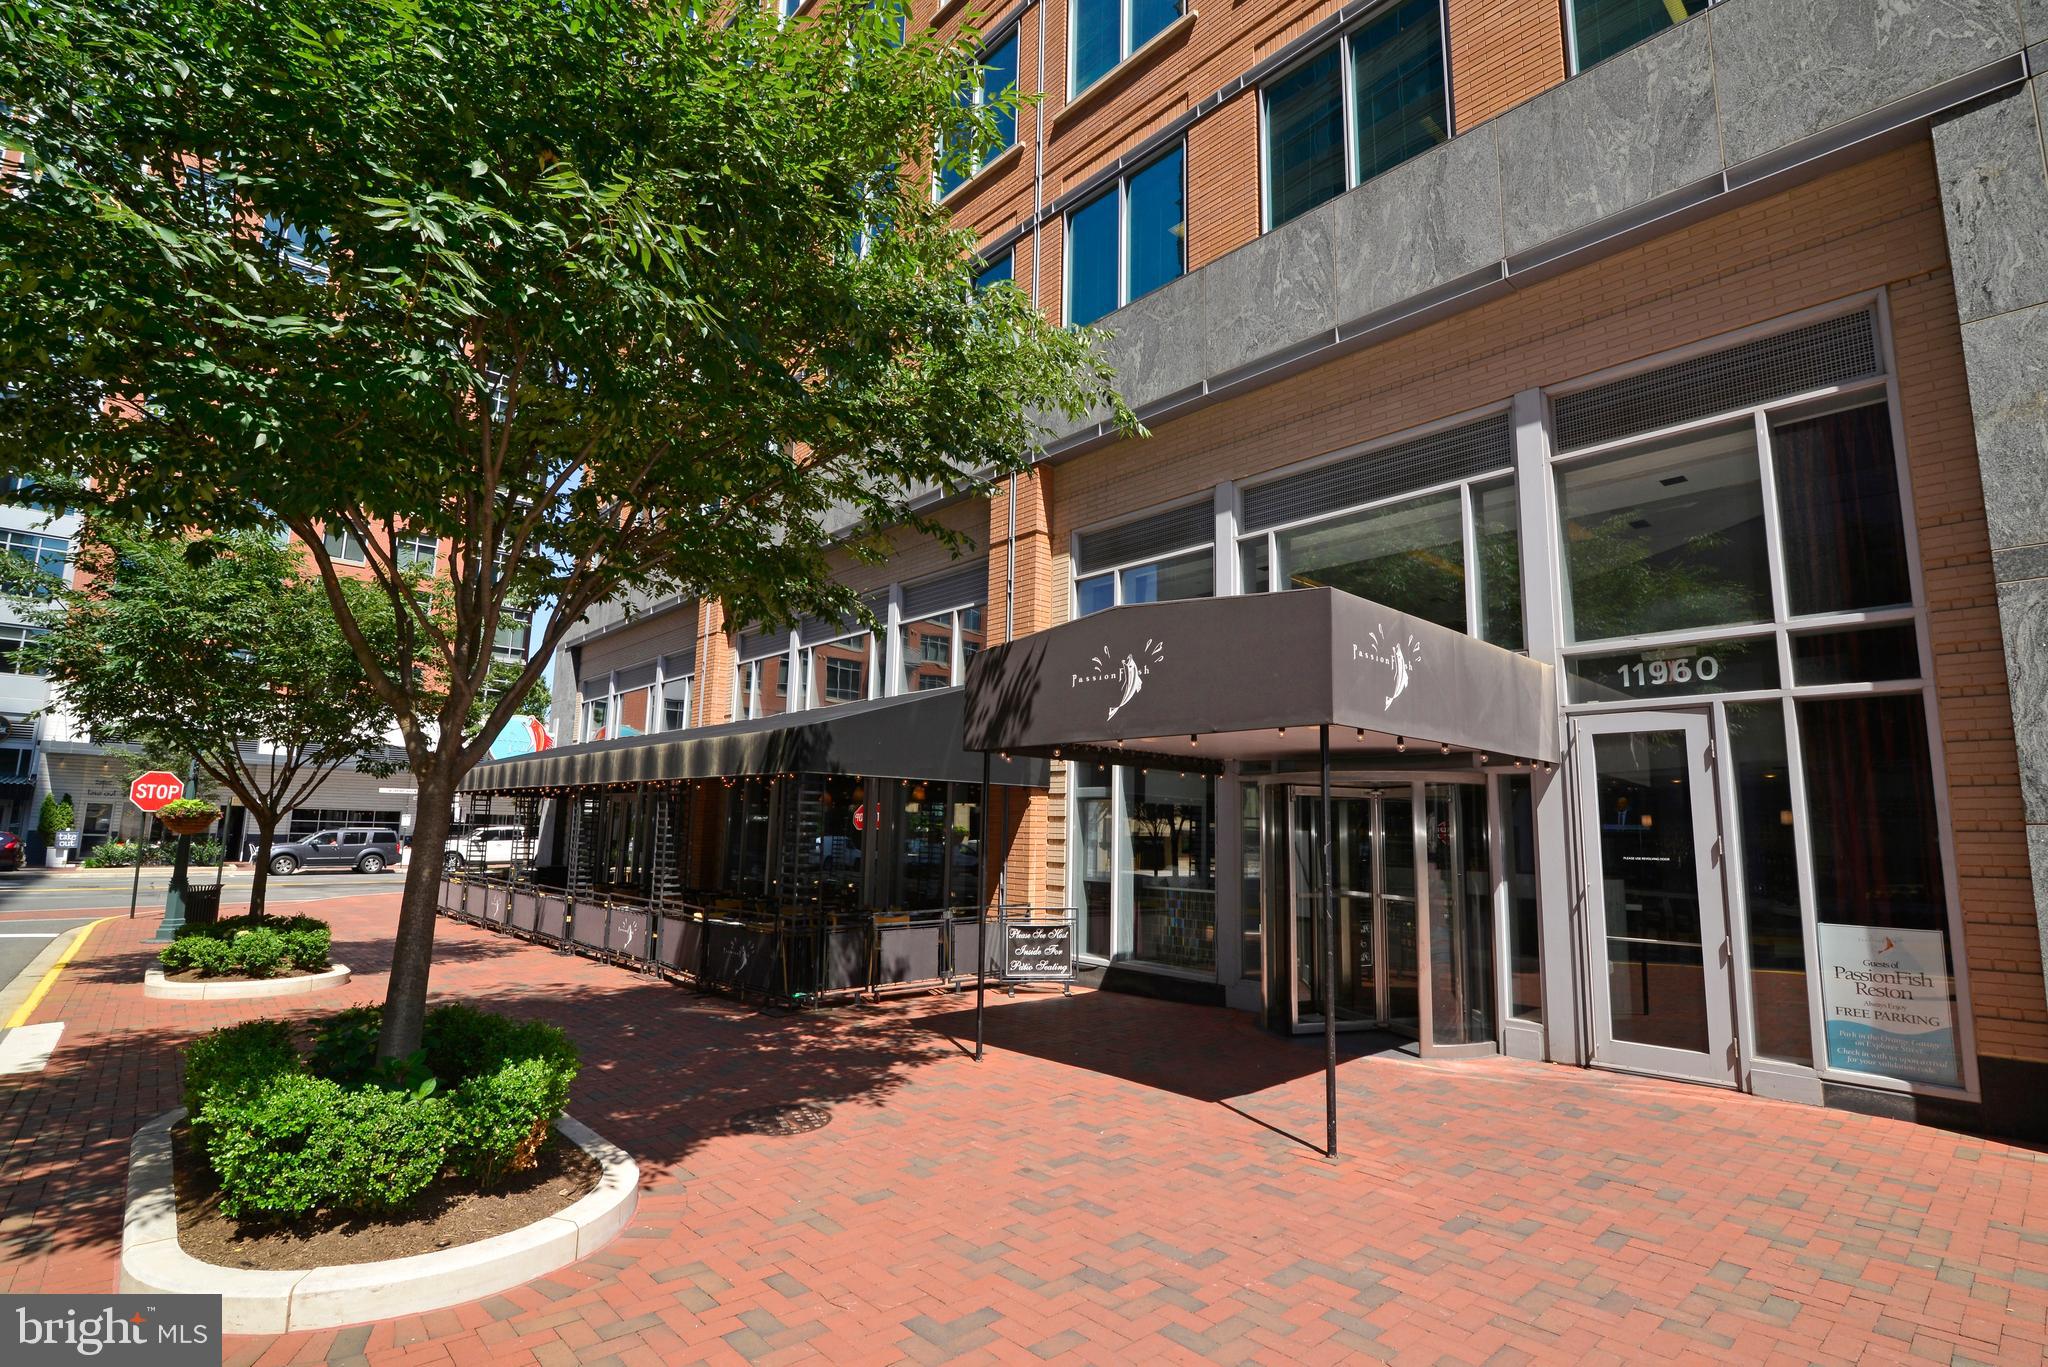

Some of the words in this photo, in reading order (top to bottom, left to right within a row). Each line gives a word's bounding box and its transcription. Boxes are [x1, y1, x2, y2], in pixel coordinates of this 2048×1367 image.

[1353, 644, 1413, 671] PassionFsh
[1072, 665, 1150, 687] PassionFsh
[1617, 656, 1718, 687] 11960
[136, 783, 179, 800] STOP
[58, 832, 77, 841] take
[1009, 928, 1031, 939] Please
[1032, 928, 1046, 939] See
[1048, 928, 1069, 939] Host
[1014, 944, 1041, 956] Inside
[1044, 944, 1063, 955] For
[1009, 960, 1033, 971] Patio
[1035, 960, 1067, 974] Seating
[1862, 959, 1889, 968] Guests
[1890, 960, 1899, 969] of
[1833, 965, 1934, 988] PassionFish
[1855, 981, 1914, 1001] Reston
[1835, 1006, 1870, 1019] FREE
[1874, 1010, 1940, 1027] PARKING
[1836, 1047, 1860, 1056] Check
[1870, 1051, 1887, 1060] with
[1847, 1055, 1858, 1063] for
[1859, 1058, 1877, 1066] your
